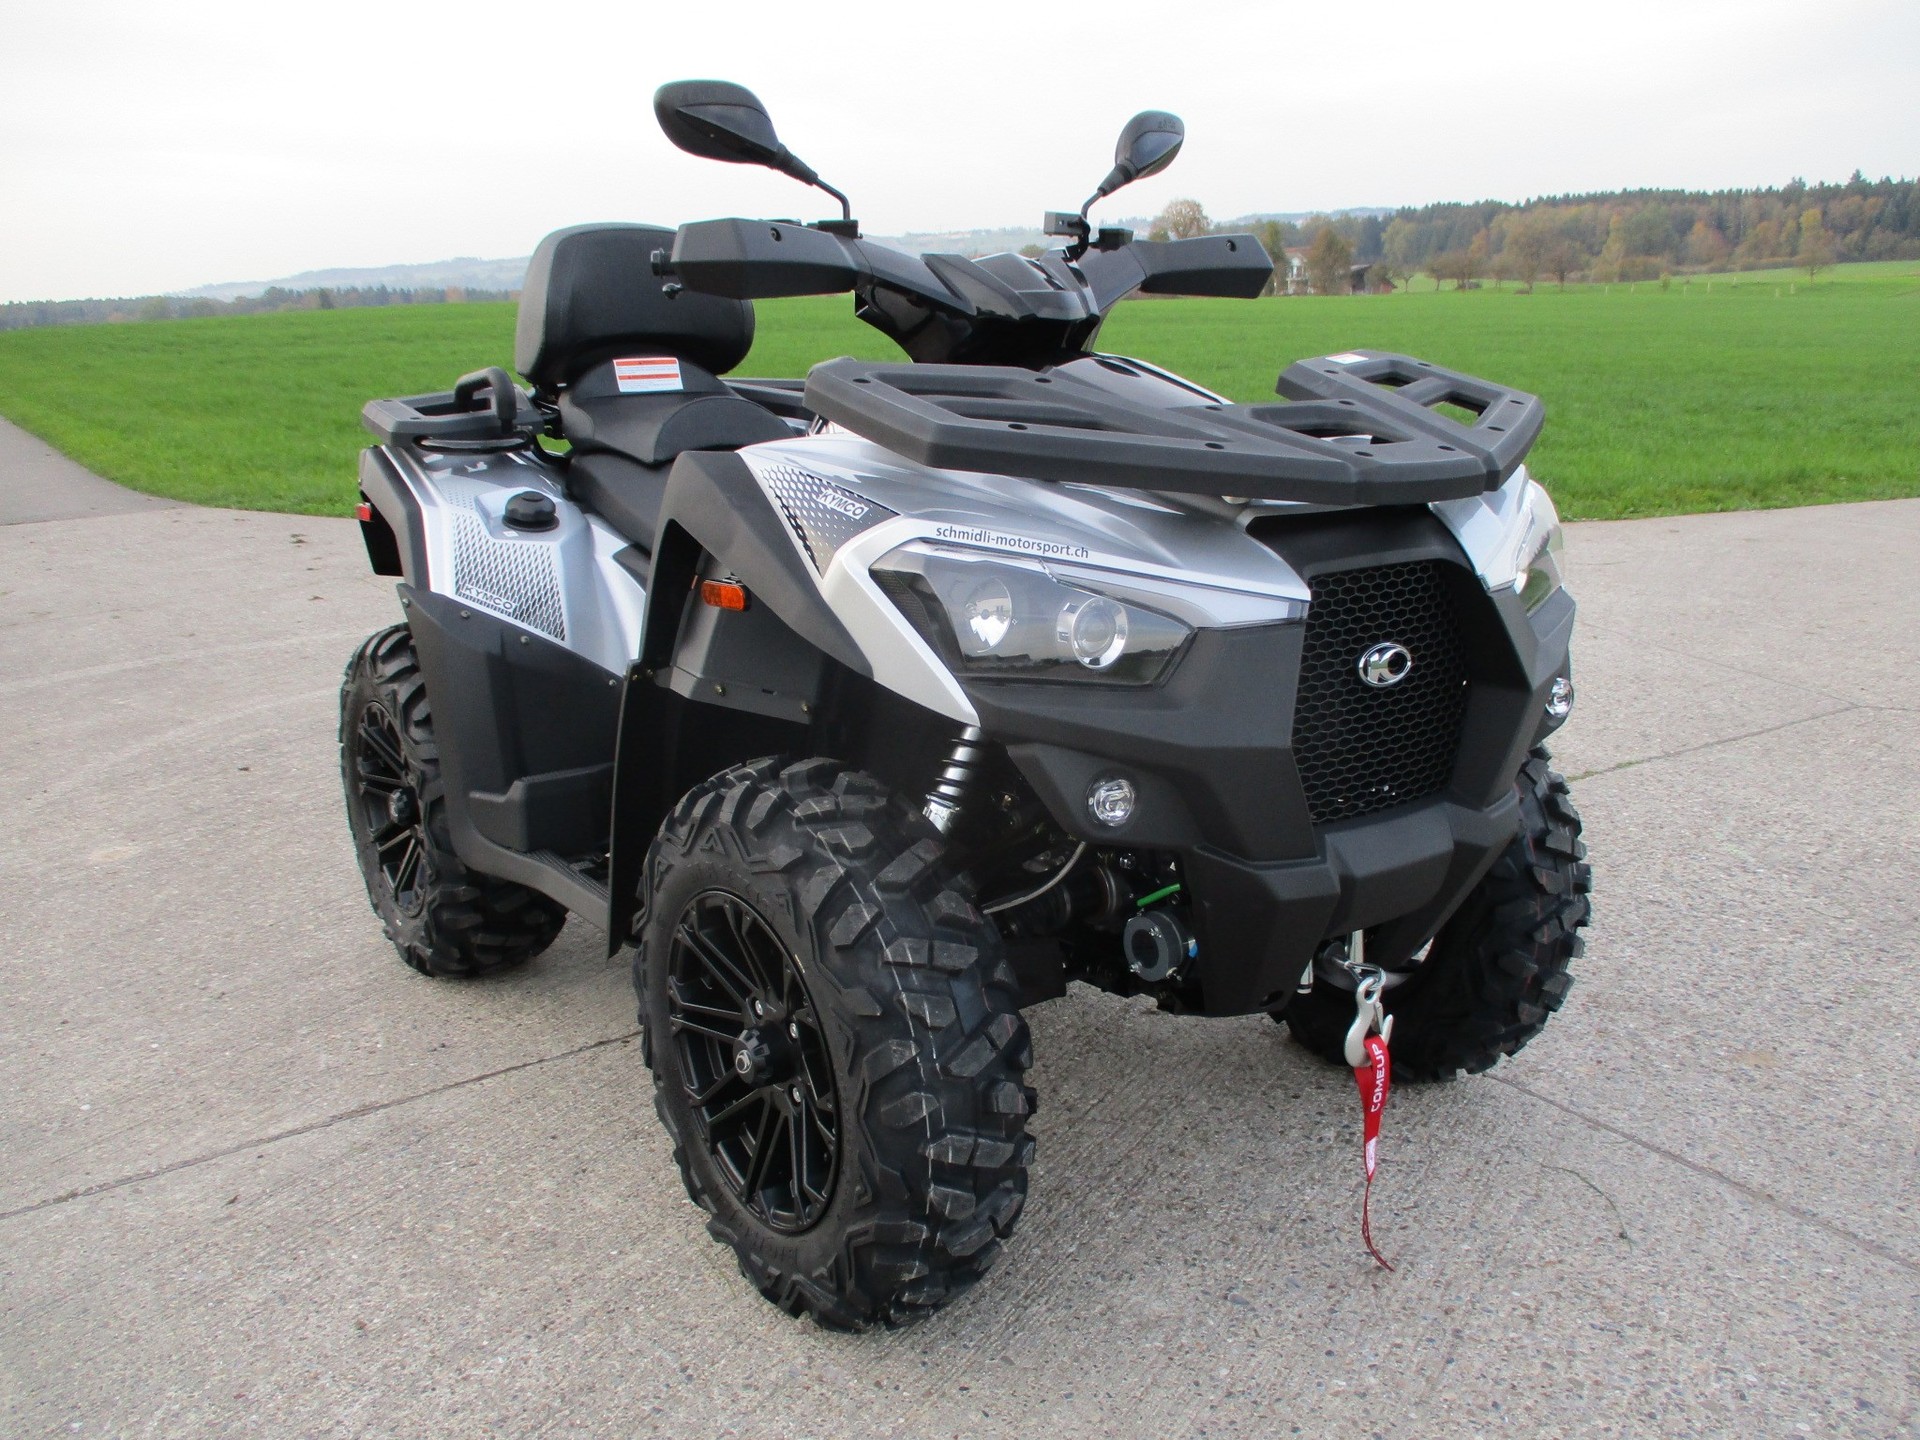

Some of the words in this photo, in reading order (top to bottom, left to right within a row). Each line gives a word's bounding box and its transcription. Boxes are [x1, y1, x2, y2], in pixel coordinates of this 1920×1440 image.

[819, 491, 865, 517] KYMCO
[936, 526, 1089, 559] schmidli-motorsport.ch
[465, 585, 513, 610] KYMCO
[1370, 1043, 1385, 1112] COMEUP
